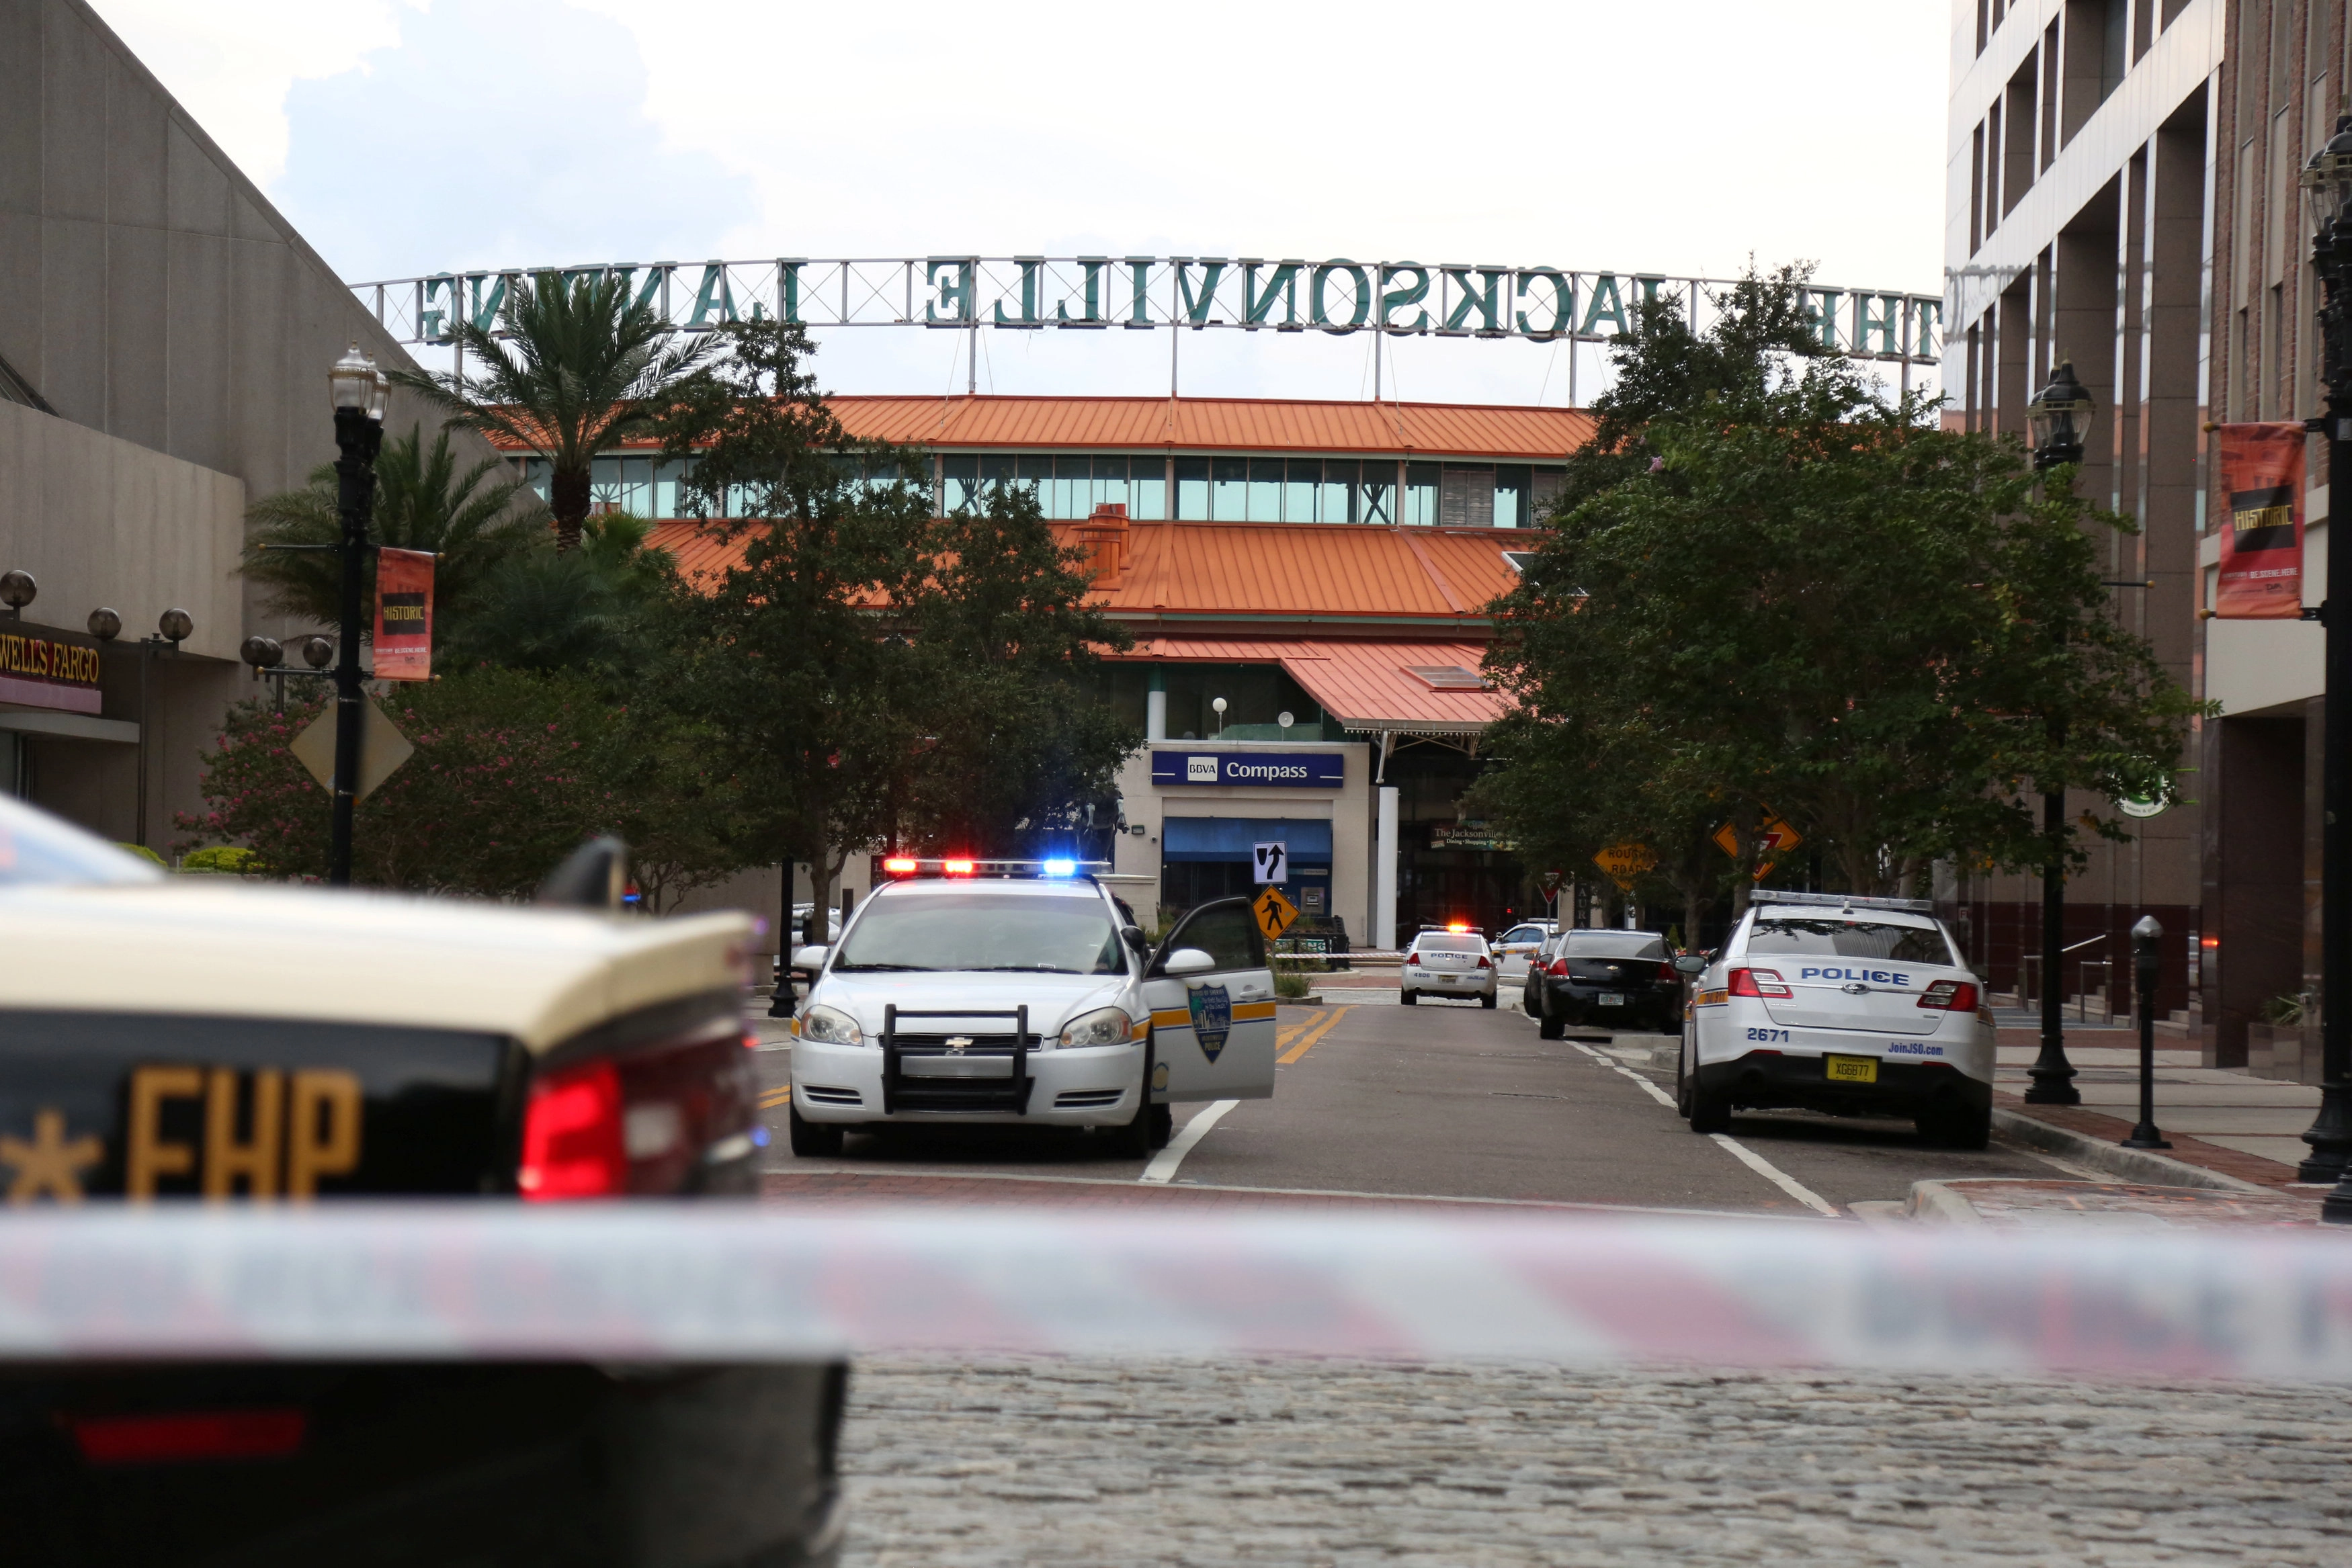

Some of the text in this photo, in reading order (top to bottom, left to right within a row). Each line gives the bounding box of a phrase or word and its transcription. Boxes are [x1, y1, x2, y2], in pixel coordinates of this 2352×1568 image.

[2234, 505, 2294, 531] HISTORIC
[383, 606, 424, 621] HISTORIC
[0, 634, 99, 683] WELLS FARGO
[1189, 762, 1308, 781] BBVA Compass
[1435, 828, 1451, 837] The
[1802, 968, 1909, 986] POLICE
[1747, 1027, 1789, 1042] 2671
[1888, 1042, 1943, 1055] JoinJSO.com
[126, 1065, 363, 1206] FHP
